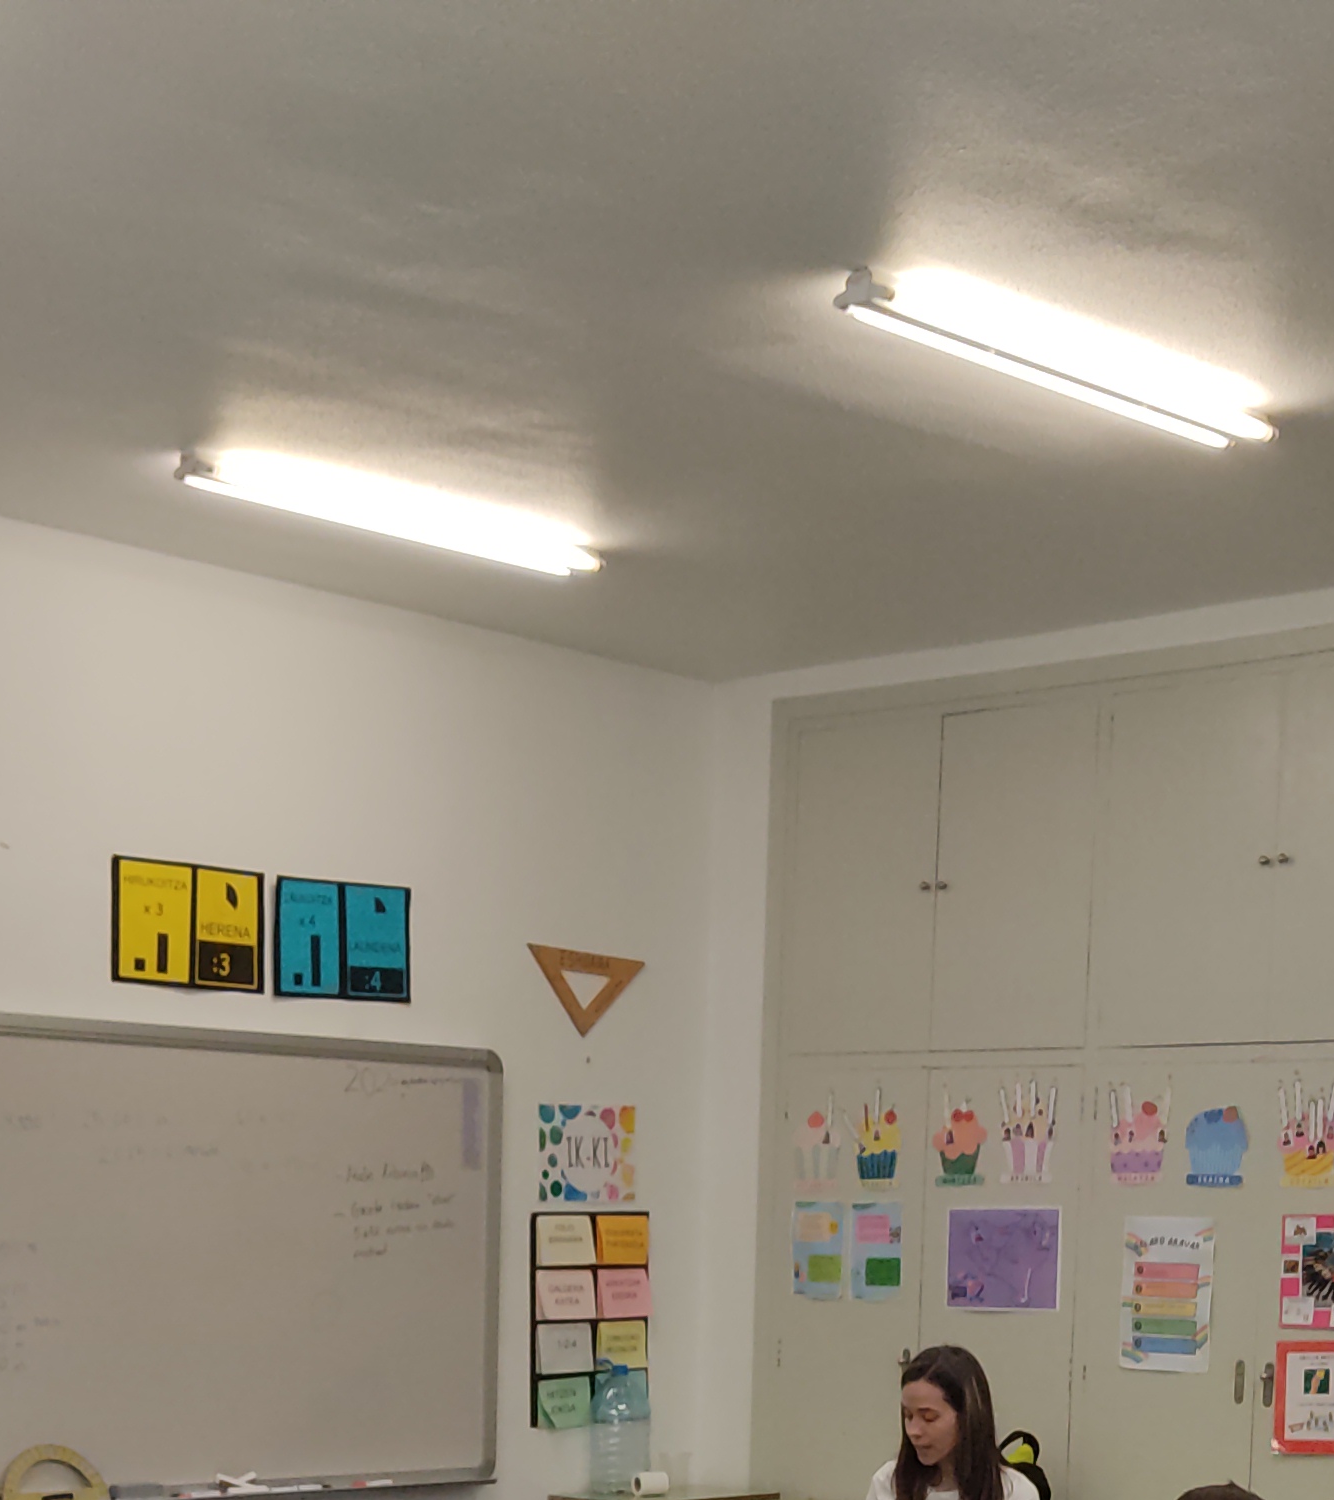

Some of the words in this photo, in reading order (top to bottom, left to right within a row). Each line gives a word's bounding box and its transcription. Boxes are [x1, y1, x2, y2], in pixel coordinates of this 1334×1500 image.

[154, 901, 164, 917] 3
[308, 915, 316, 926] 4
[200, 922, 251, 939] HERENA
[566, 1135, 611, 1170] IK-KI
